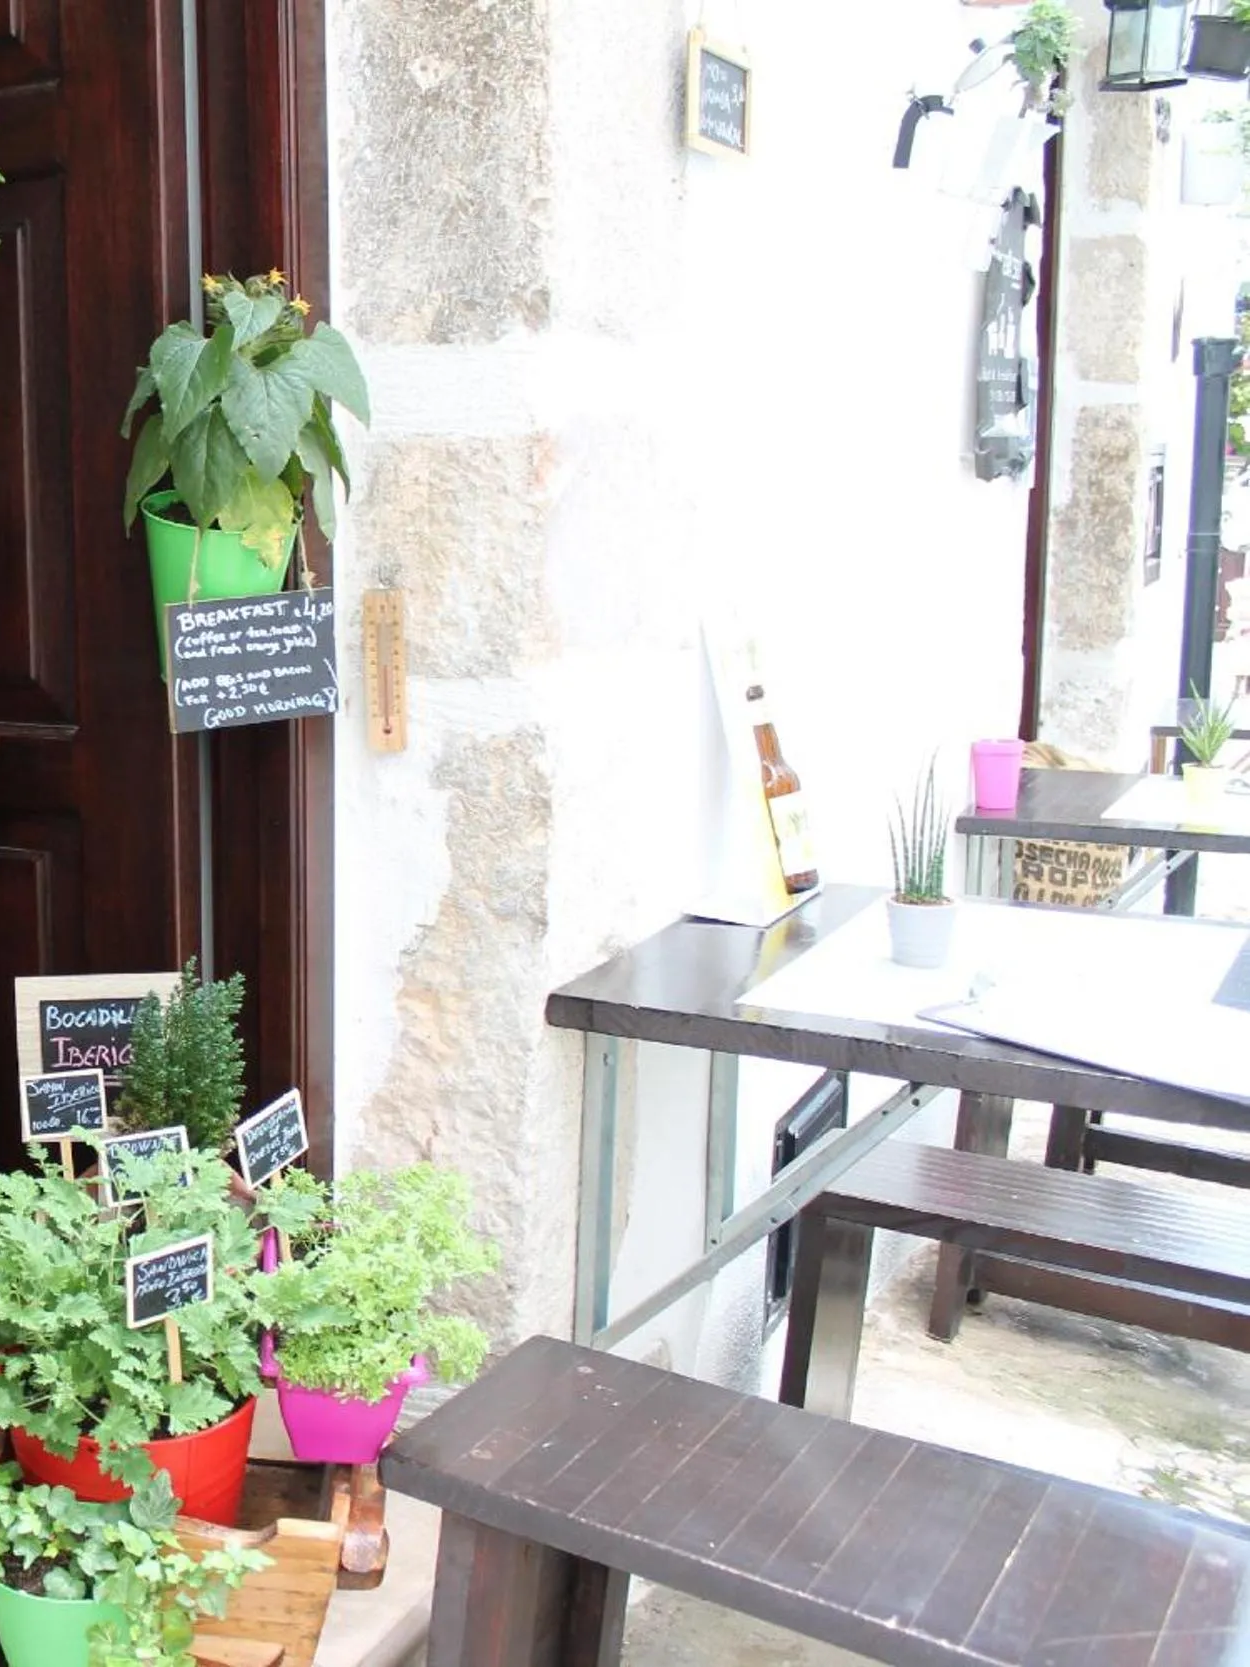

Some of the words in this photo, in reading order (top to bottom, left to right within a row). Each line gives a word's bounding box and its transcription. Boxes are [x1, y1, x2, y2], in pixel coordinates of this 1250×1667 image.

[176, 600, 289, 632] BREAKFAST
[203, 705, 247, 729] GOOD
[49, 1036, 134, 1068] IBERIC
